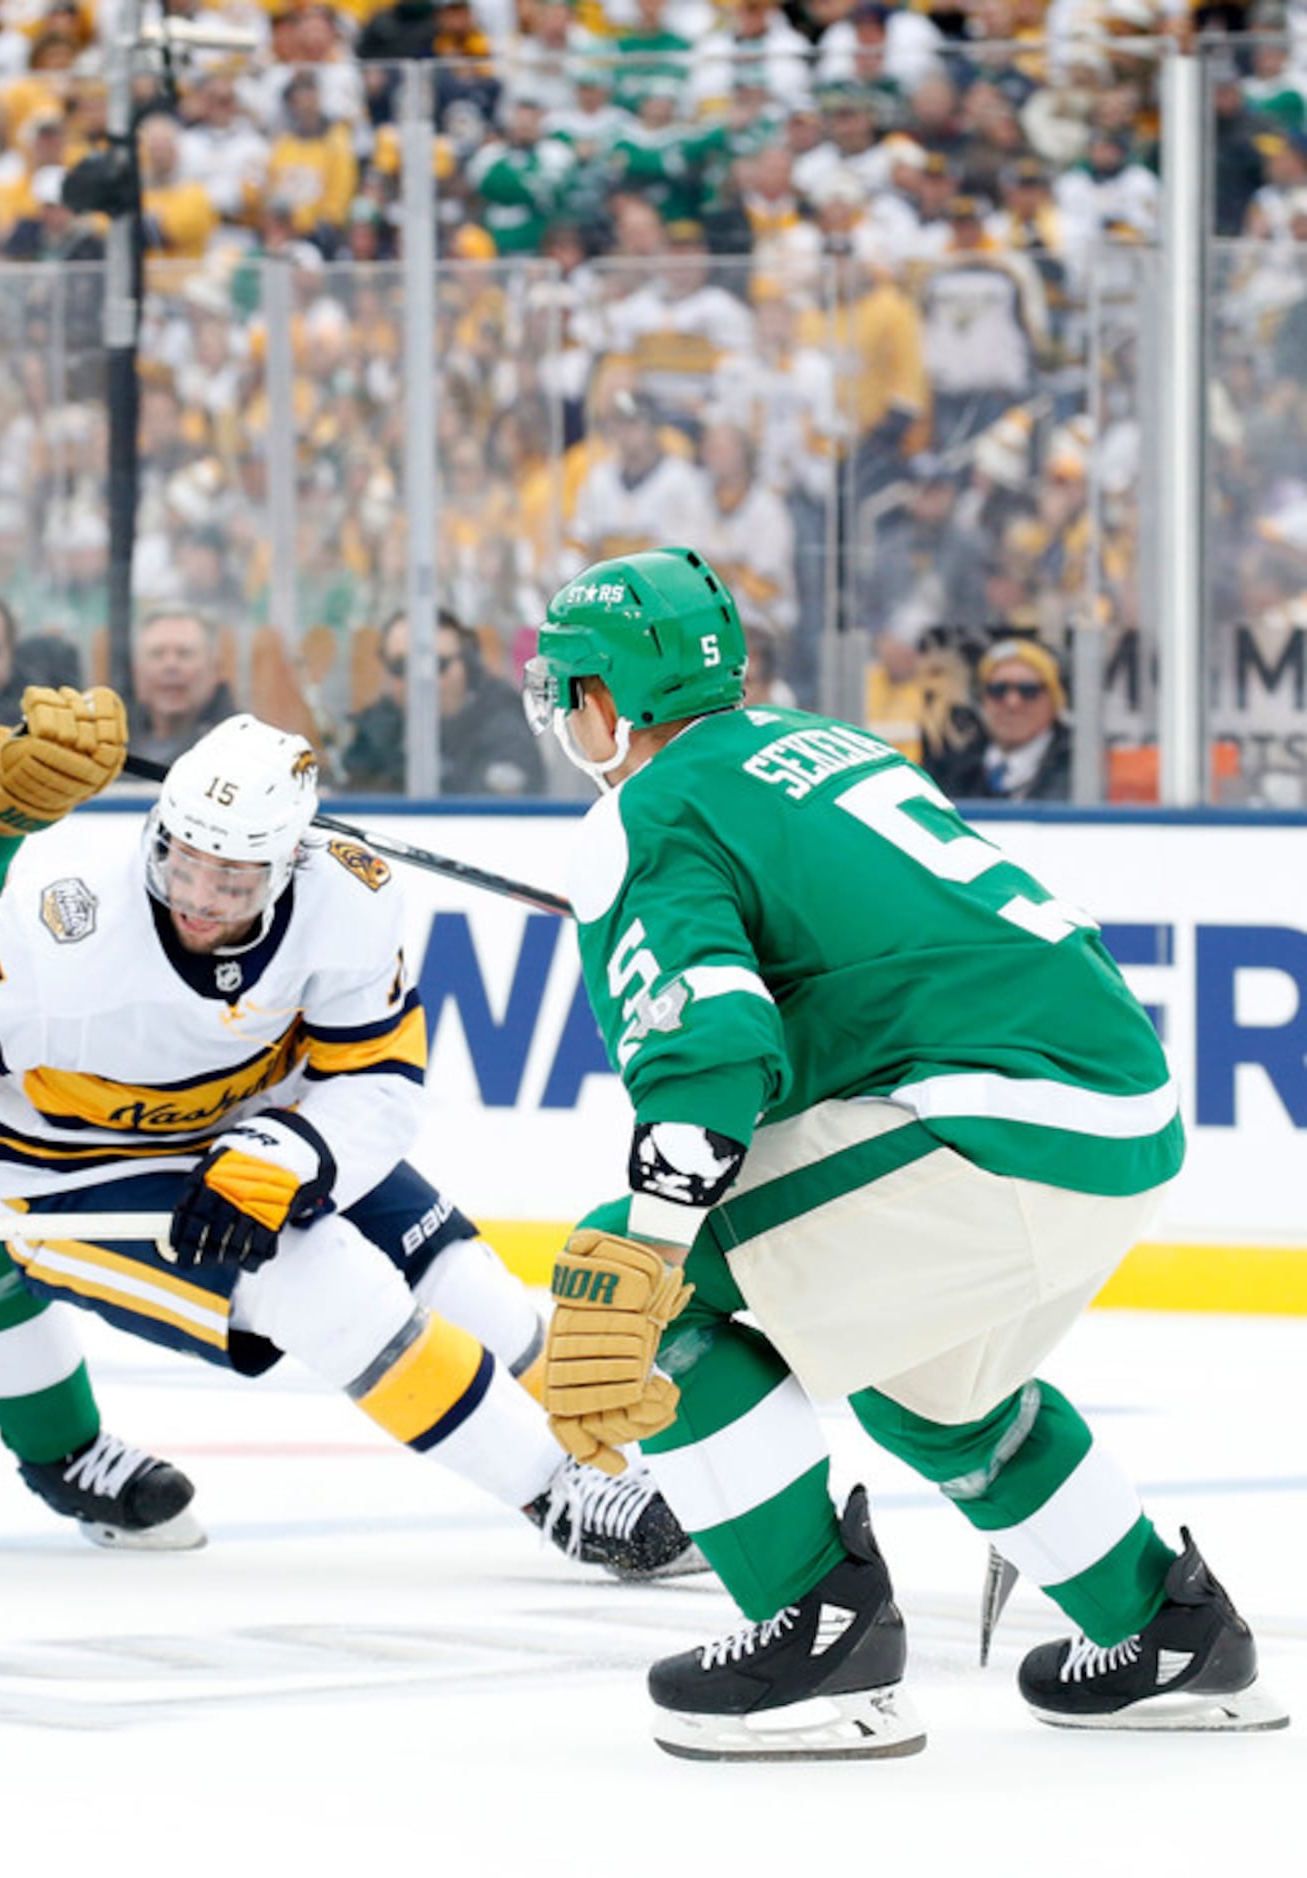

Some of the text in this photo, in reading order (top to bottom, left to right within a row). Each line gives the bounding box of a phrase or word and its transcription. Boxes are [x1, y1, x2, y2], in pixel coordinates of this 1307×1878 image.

[700, 634, 721, 667] 5
[204, 776, 239, 807] 15
[833, 765, 1102, 944] 5
